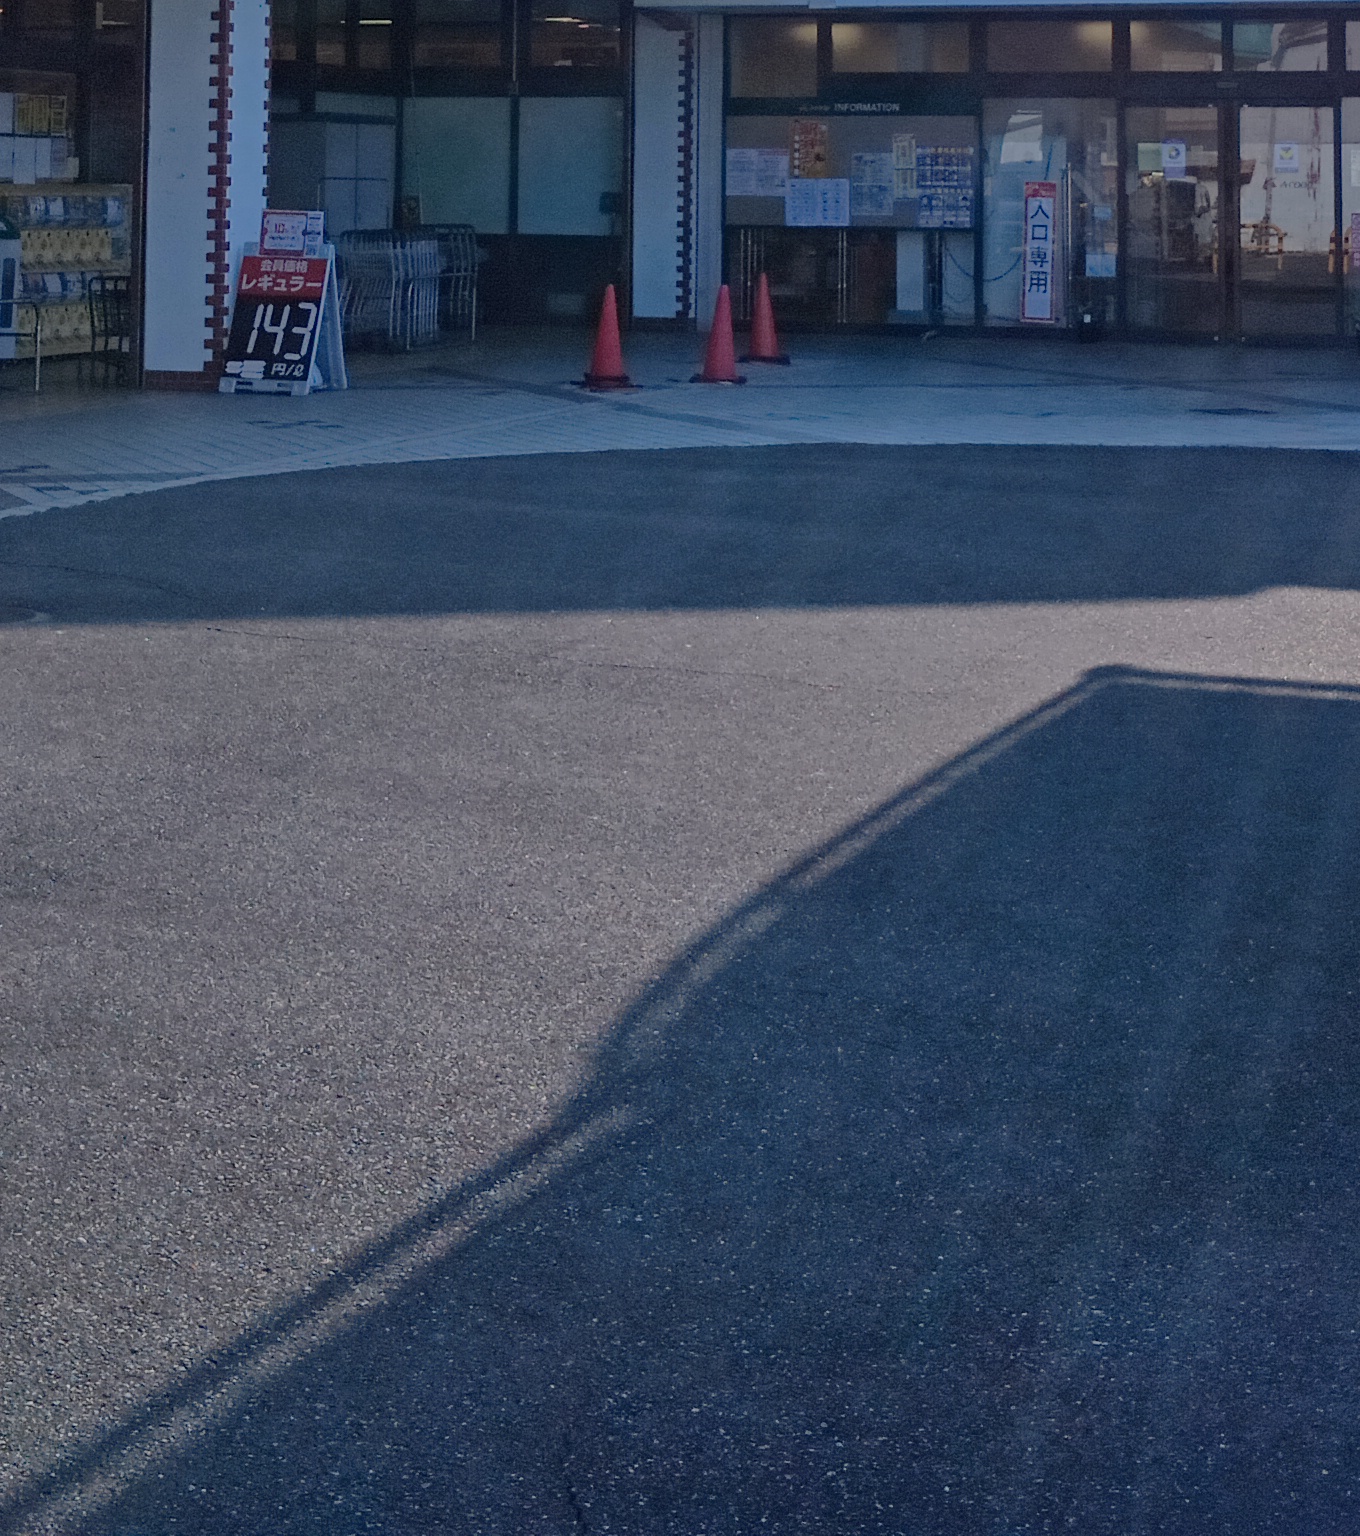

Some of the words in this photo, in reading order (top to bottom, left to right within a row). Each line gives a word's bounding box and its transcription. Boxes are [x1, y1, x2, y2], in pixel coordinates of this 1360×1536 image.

[833, 102, 901, 112] INFORMATION
[1028, 199, 1050, 294] 入口専用
[260, 260, 309, 273] 会員価格
[241, 274, 322, 293] レギュラー
[246, 301, 318, 361] 143
